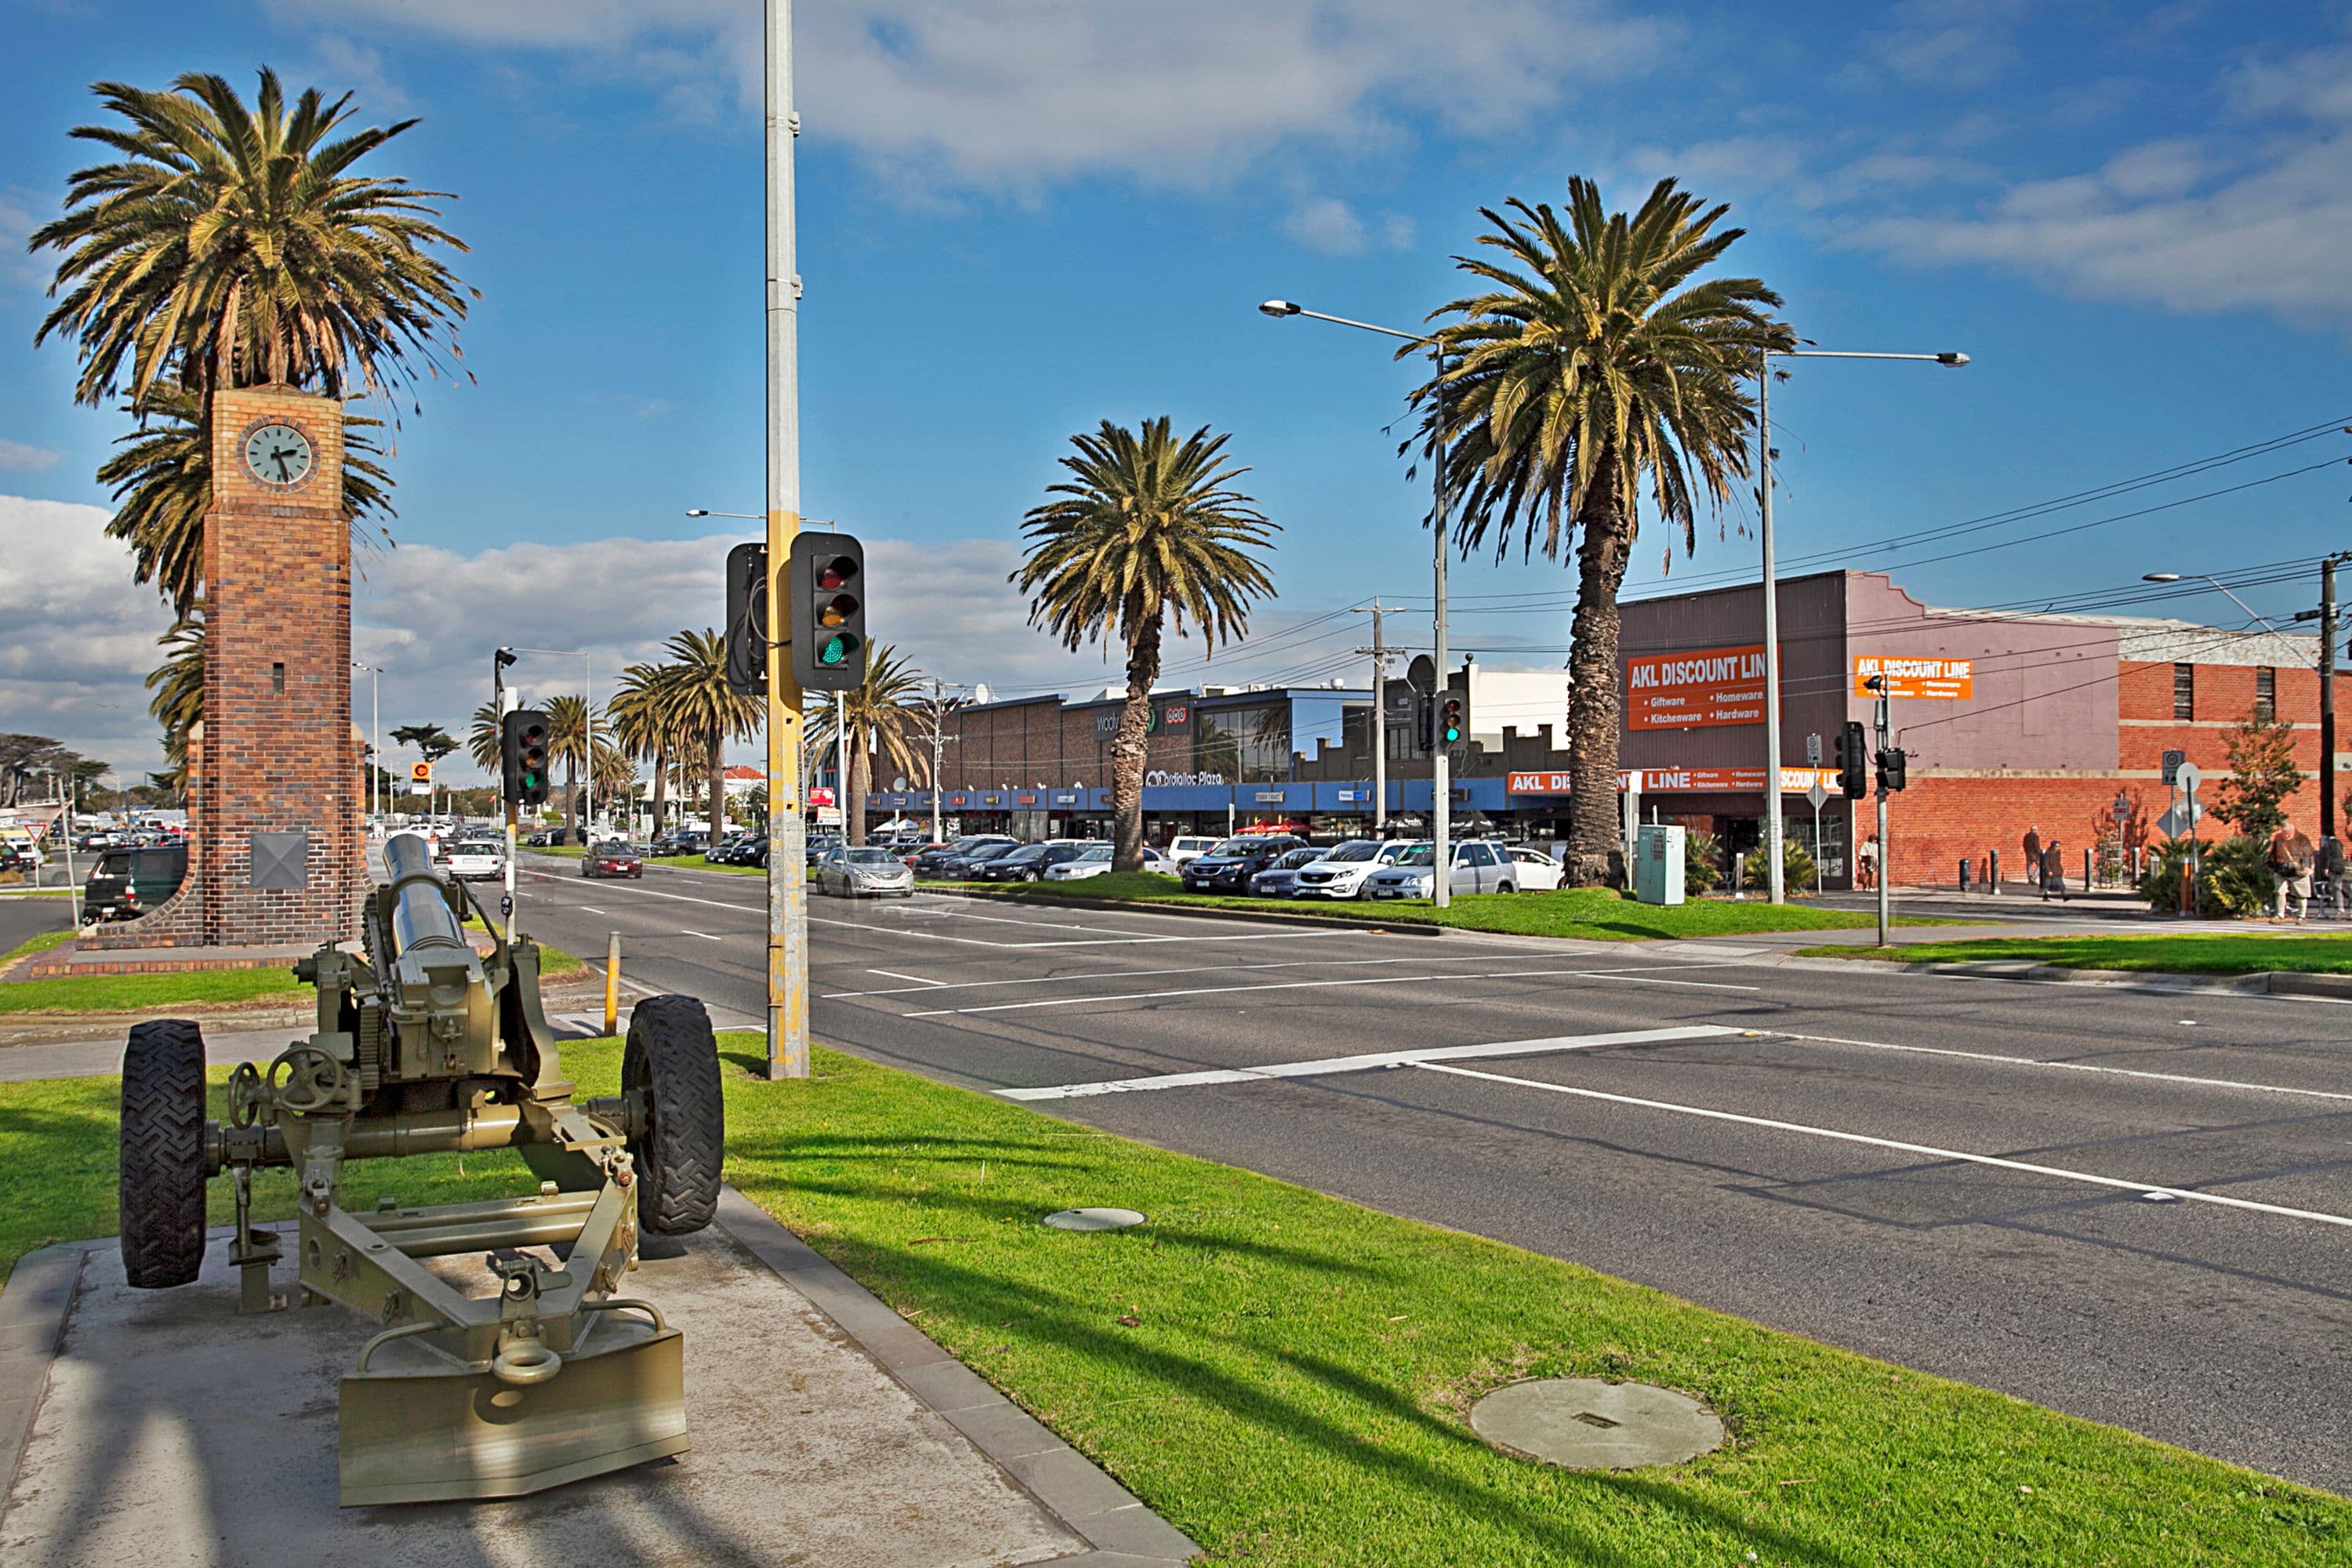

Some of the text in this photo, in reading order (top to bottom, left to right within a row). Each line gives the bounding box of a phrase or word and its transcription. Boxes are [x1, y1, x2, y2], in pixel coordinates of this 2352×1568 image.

[1631, 652, 1766, 688] AKL DISCOUNT LIN
[1857, 658, 1971, 679] AKL DISCOUNT LINE
[1651, 691, 1763, 708] Giftware Homeware
[1650, 709, 1760, 724] Kitchenware Hardware
[1199, 771, 1223, 786] Plaza
[1512, 775, 1544, 790] AKL
[1648, 772, 1691, 789] LINE
